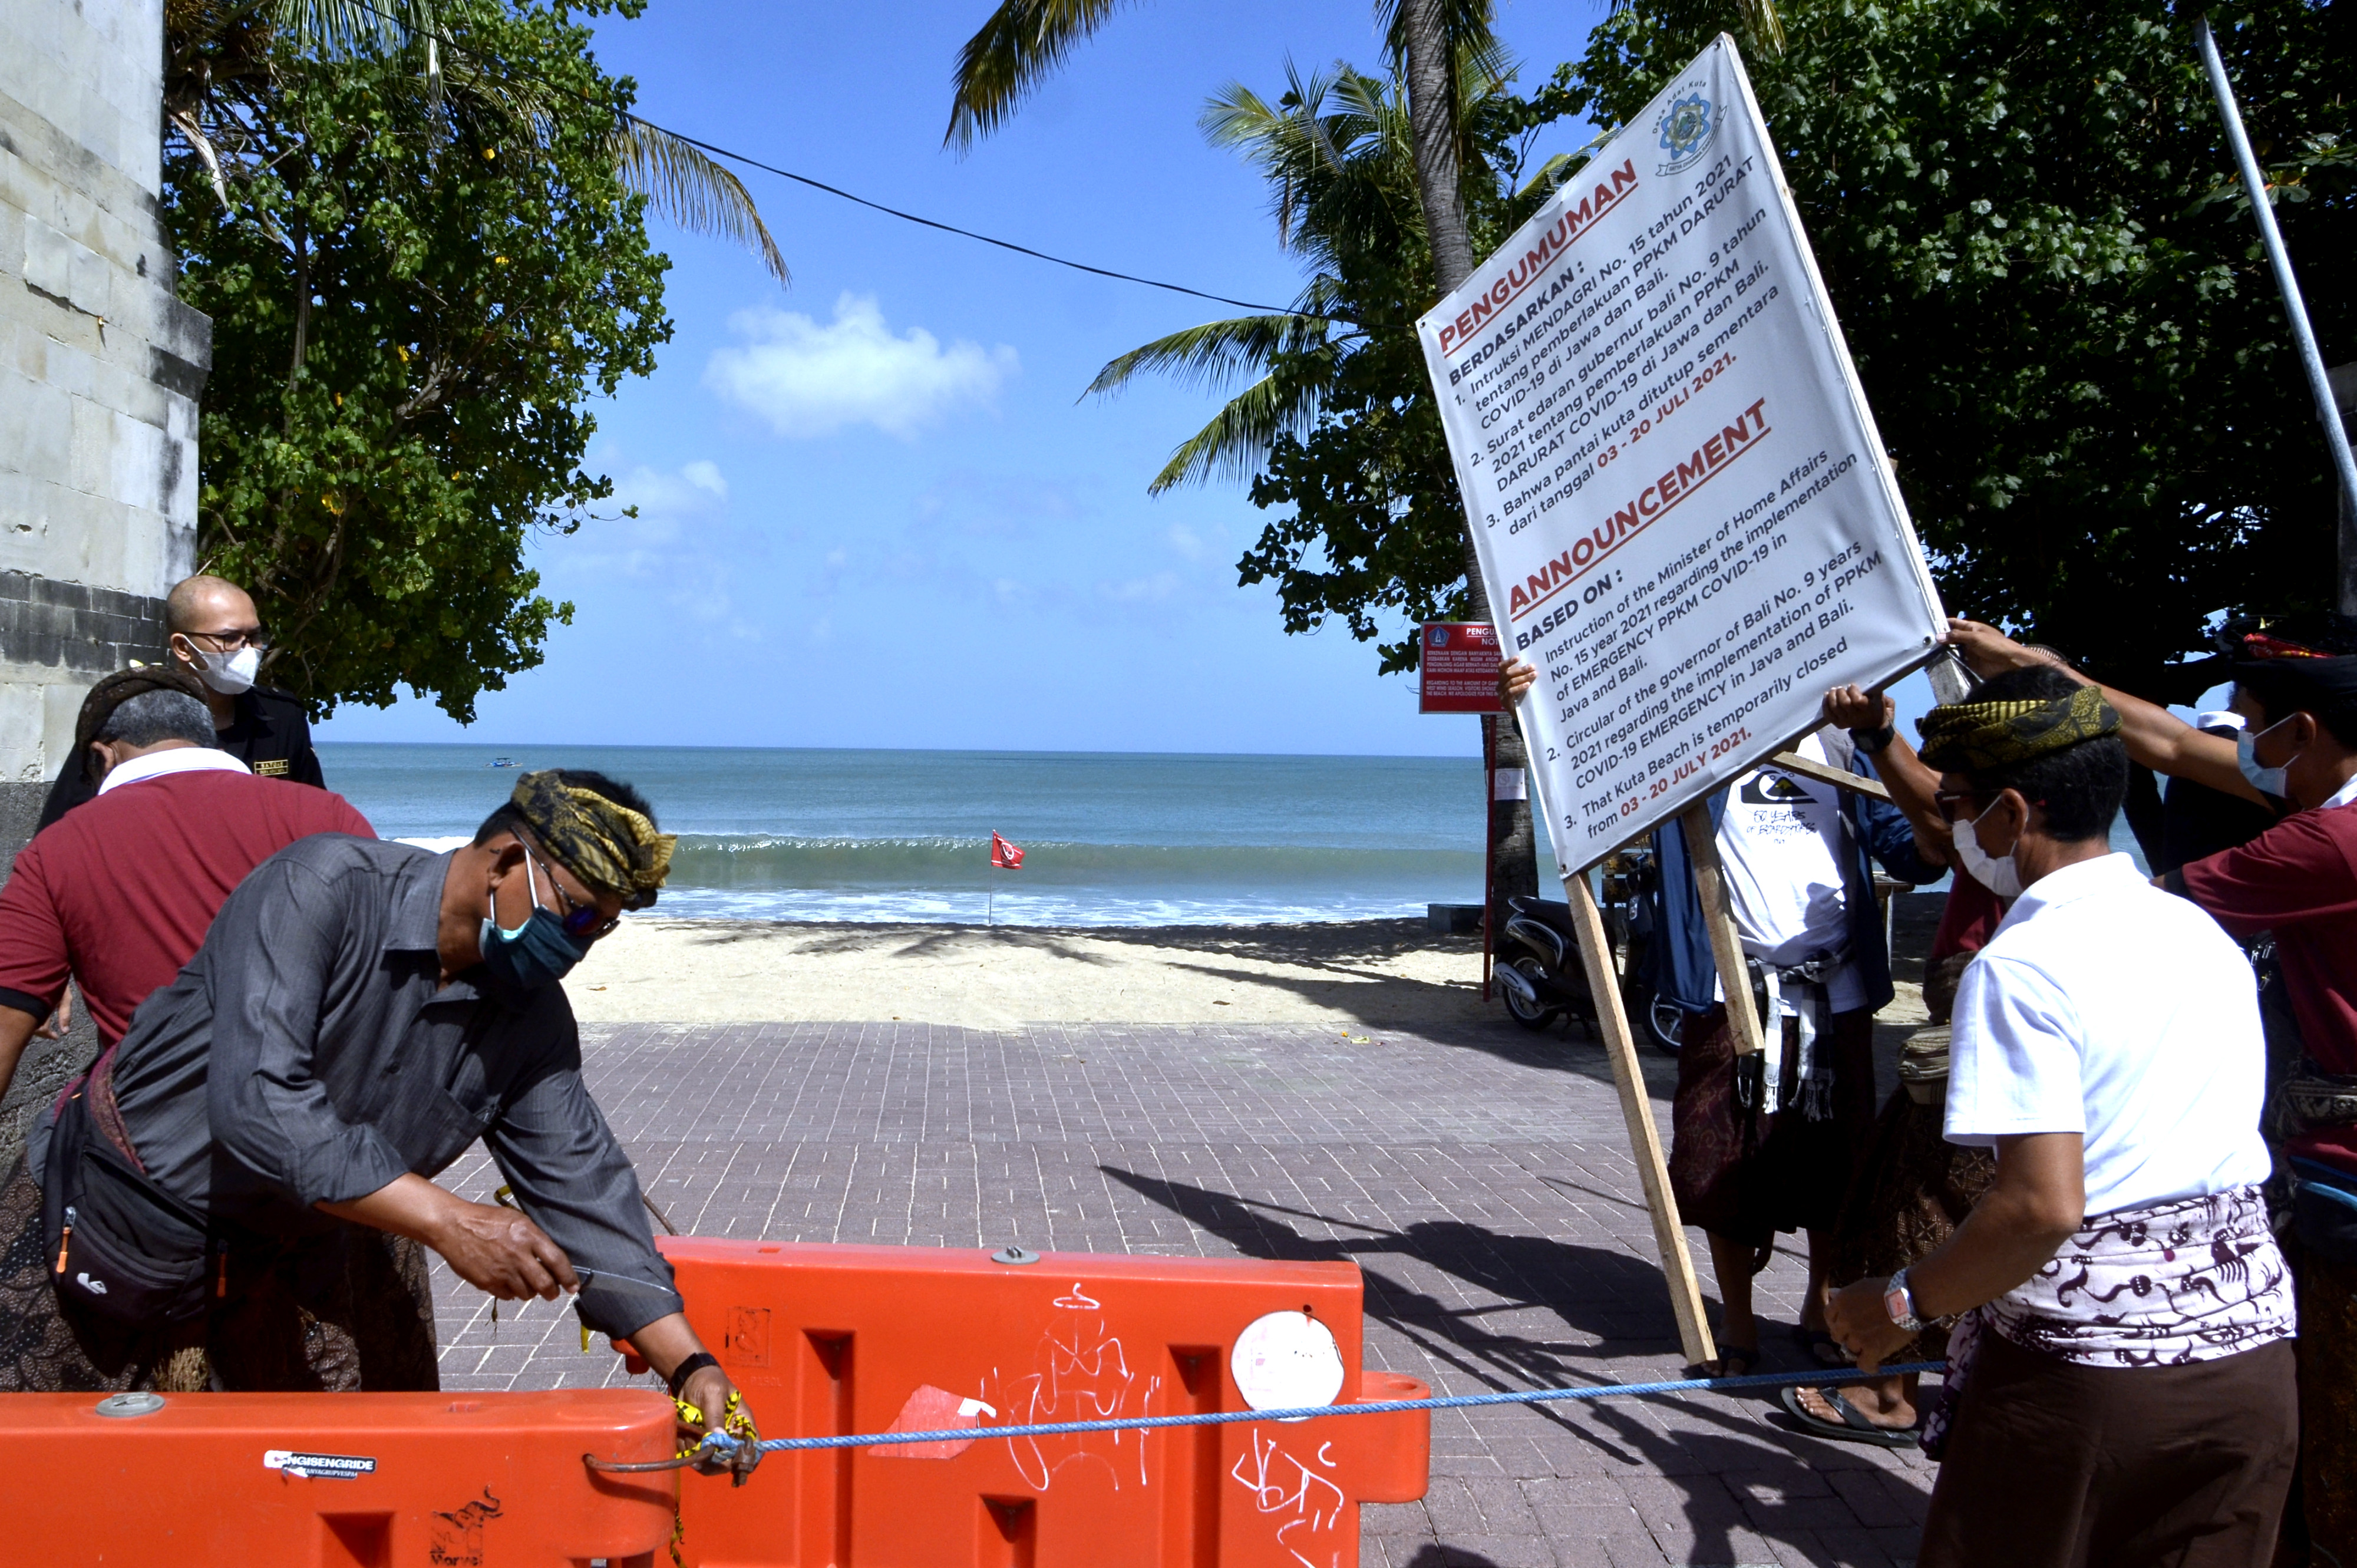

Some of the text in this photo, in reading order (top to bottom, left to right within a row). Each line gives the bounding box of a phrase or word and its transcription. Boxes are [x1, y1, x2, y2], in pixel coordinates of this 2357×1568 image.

[1652, 79, 1707, 134] Desa Adat Kuta
[1438, 158, 1636, 352] PENGUMUMAN
[1448, 266, 1574, 387] BERDASARKAN
[1455, 154, 1731, 405] 1. Intruksi MENDAGRI No. 15 tahun 2021
[1470, 208, 1766, 467] 2. Surat edaran gubernur bali No. 9 tahun
[1475, 156, 1752, 411] tentang pemberlakuan PPKM DARURAT
[1481, 267, 1668, 429] COVID-19 di Jawa dan Bali.
[1486, 286, 1778, 528] 3. Bahwa pantai kuta ditutup sementara
[1492, 258, 1739, 473] 2021 tentang pemberlakuan PPKM
[1497, 260, 1768, 492] DARURAT COVID-19 di Jawa dan Bali.
[1509, 352, 1736, 534] dari tanggal 03 20 JULI 2021.
[1510, 397, 1765, 615] ANNOUNCEMENT
[1545, 450, 1827, 663] Instruction of the Minister of Home Affairs
[1550, 453, 1857, 682] No. 15 year 2021 regarding the implementation
[1516, 573, 1612, 651] BASED ON
[1546, 541, 1861, 761] 2. Circular of the governor of Bali No. 9 years
[1556, 533, 1787, 701] of EMERGENCY PPKM COVID-19 in
[1560, 655, 1647, 722] Java and Bali.
[1571, 549, 1882, 770] 2021 regarding the implementation of PPKM
[1576, 599, 1853, 788] COVID-19 EMERGENCY in Java and Bali.
[1564, 636, 1847, 829] 3. That Kuta Beach is temporarily closed
[1587, 727, 1751, 839] from 03 20 JULY 2021.
